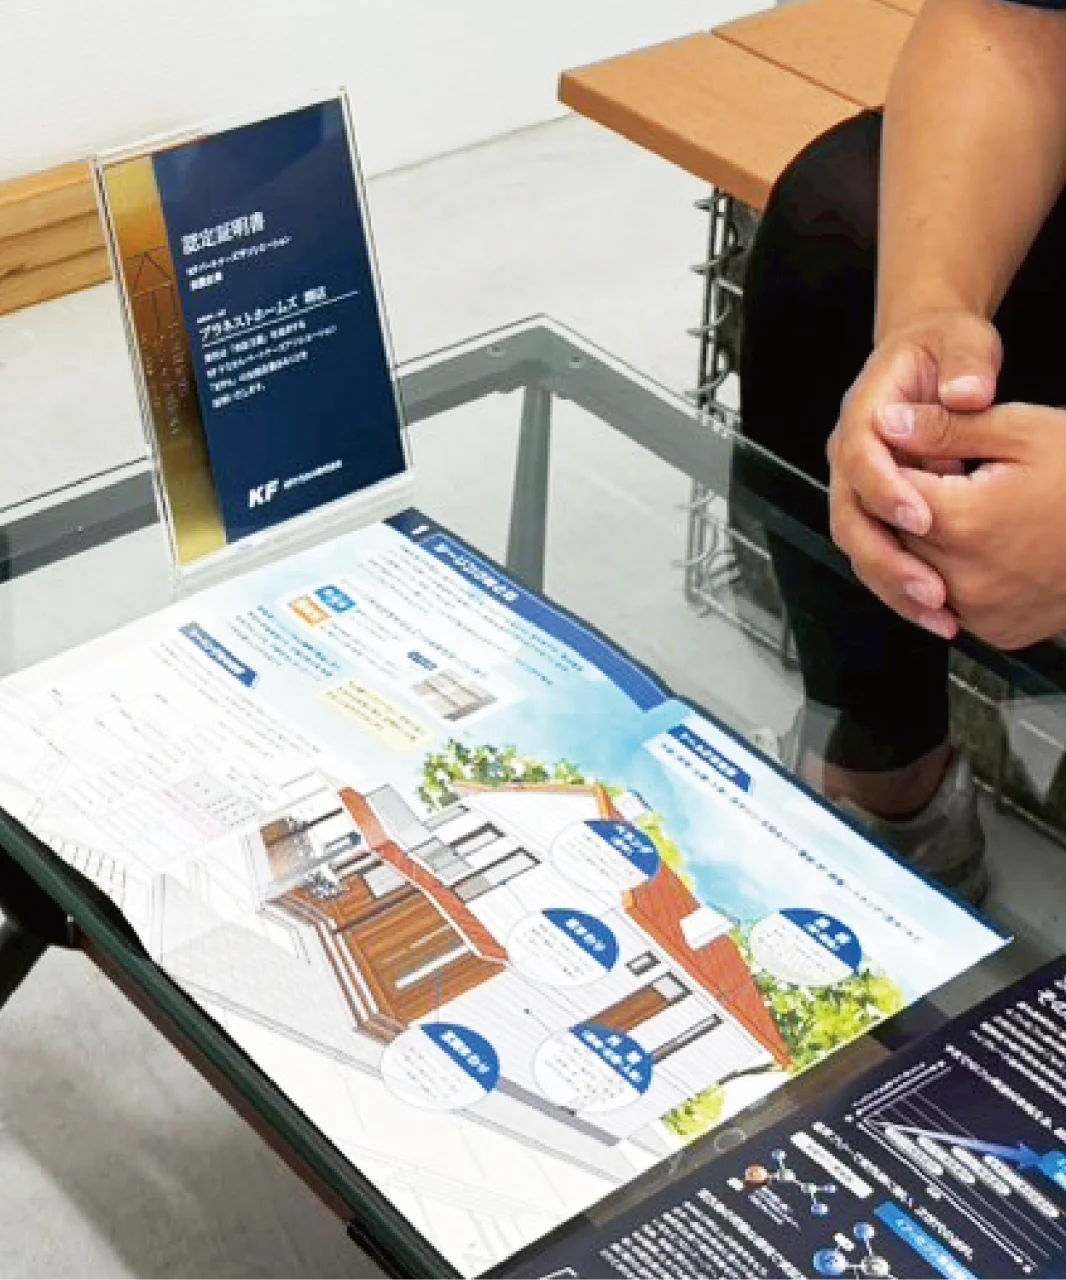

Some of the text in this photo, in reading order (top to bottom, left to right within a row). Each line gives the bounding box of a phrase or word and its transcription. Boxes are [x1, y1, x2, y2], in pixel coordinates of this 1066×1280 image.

[182, 211, 264, 255] 認定証明書
[248, 478, 279, 508] KF
